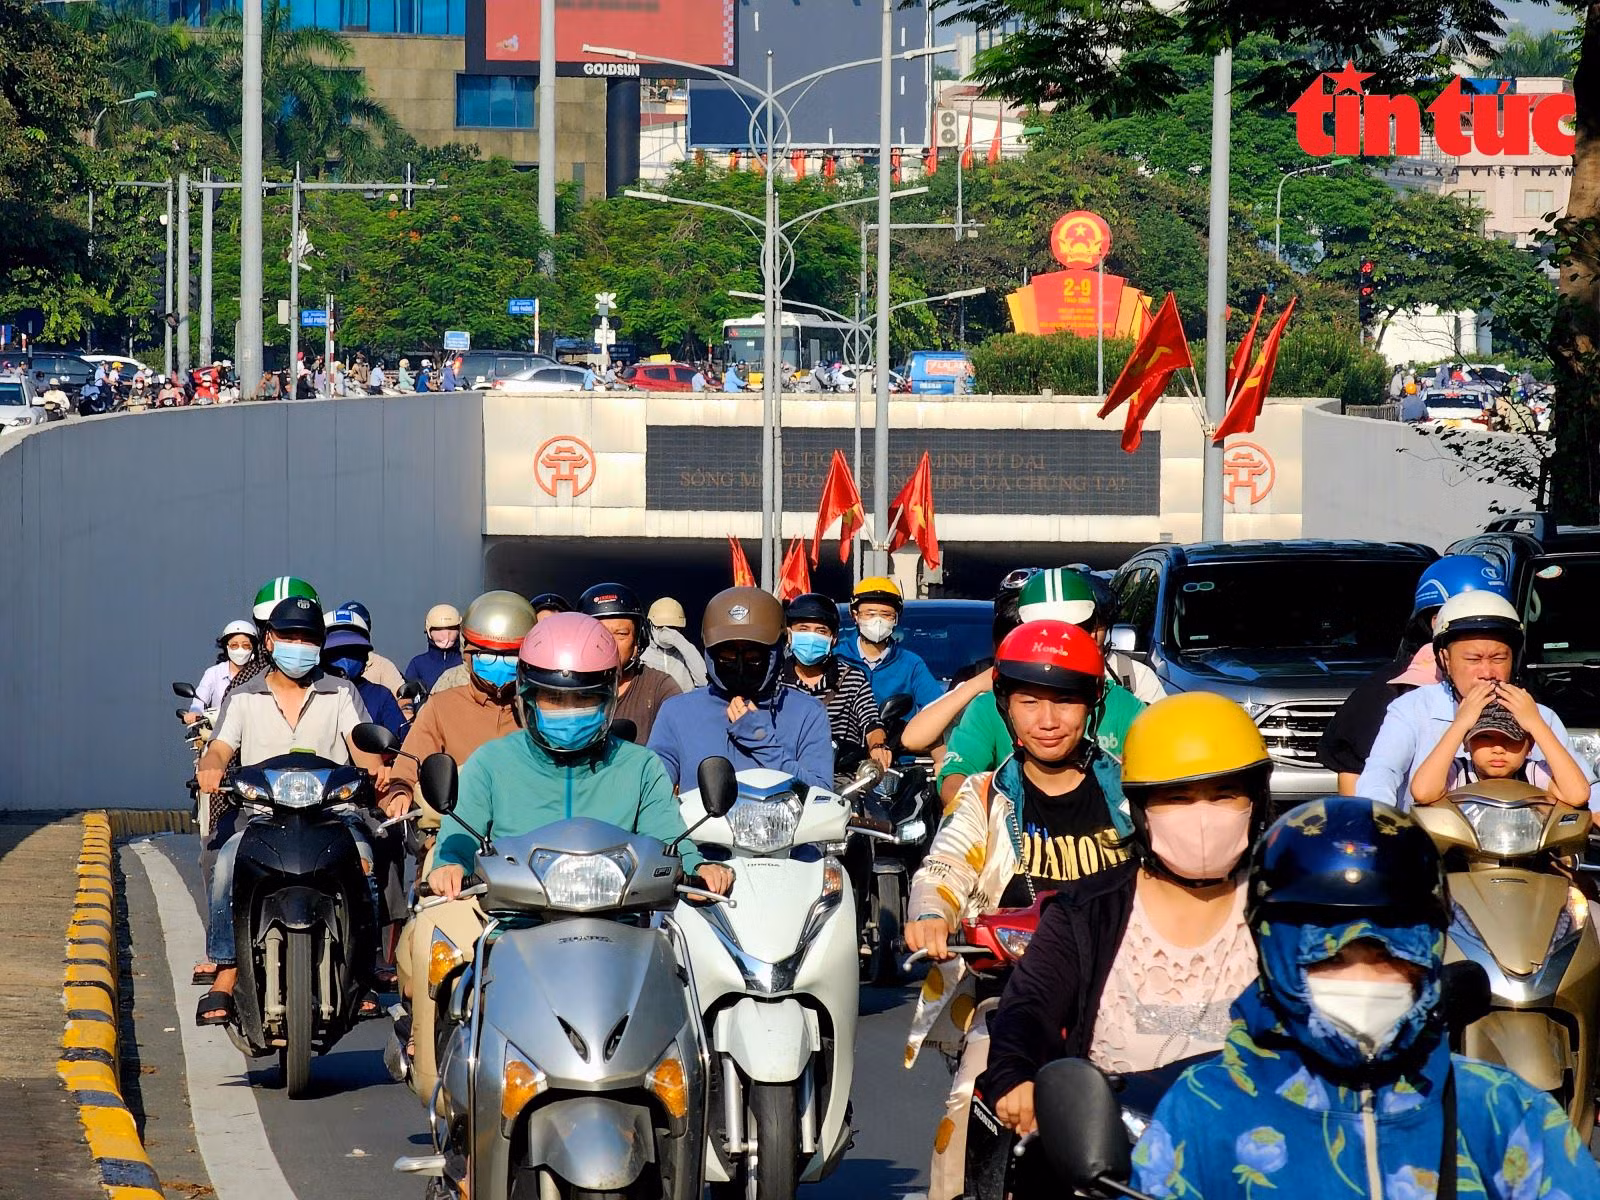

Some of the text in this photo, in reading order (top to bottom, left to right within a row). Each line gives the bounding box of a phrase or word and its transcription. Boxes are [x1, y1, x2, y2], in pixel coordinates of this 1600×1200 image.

[583, 63, 640, 76] GOLDSUN
[1063, 278, 1091, 297] 2-9
[973, 1103, 998, 1136] HONDA
